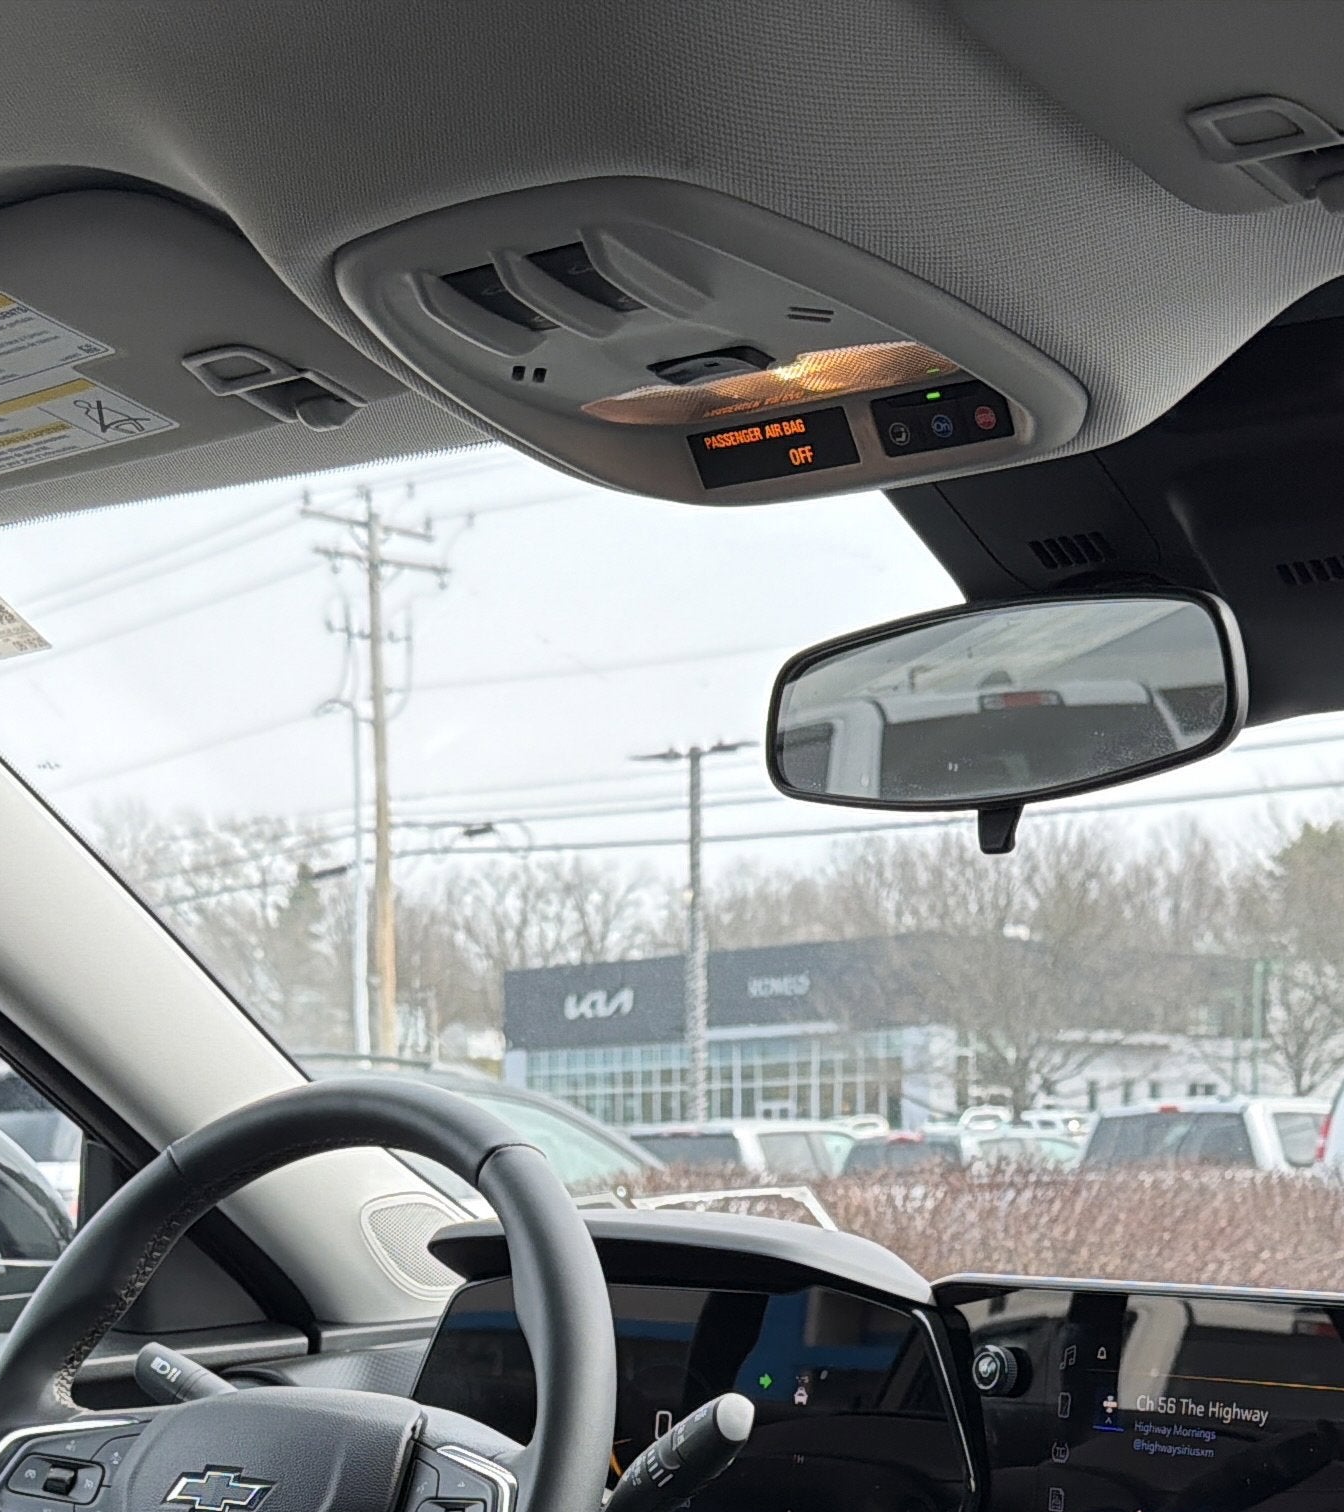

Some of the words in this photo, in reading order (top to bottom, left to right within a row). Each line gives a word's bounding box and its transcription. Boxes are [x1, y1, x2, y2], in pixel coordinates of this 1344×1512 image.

[704, 425, 763, 450] PASSENGER
[764, 421, 784, 440] AIR
[783, 419, 806, 435] BAG
[788, 446, 814, 466] OFF
[1136, 1394, 1154, 1412] Ch
[1157, 1397, 1176, 1415] 56
[1179, 1398, 1205, 1417] The
[1208, 1401, 1269, 1427] Highway
[1134, 1420, 1172, 1438] Highway
[1172, 1424, 1217, 1442] Mornings
[1133, 1439, 1215, 1458] @highwaysiriusxm
